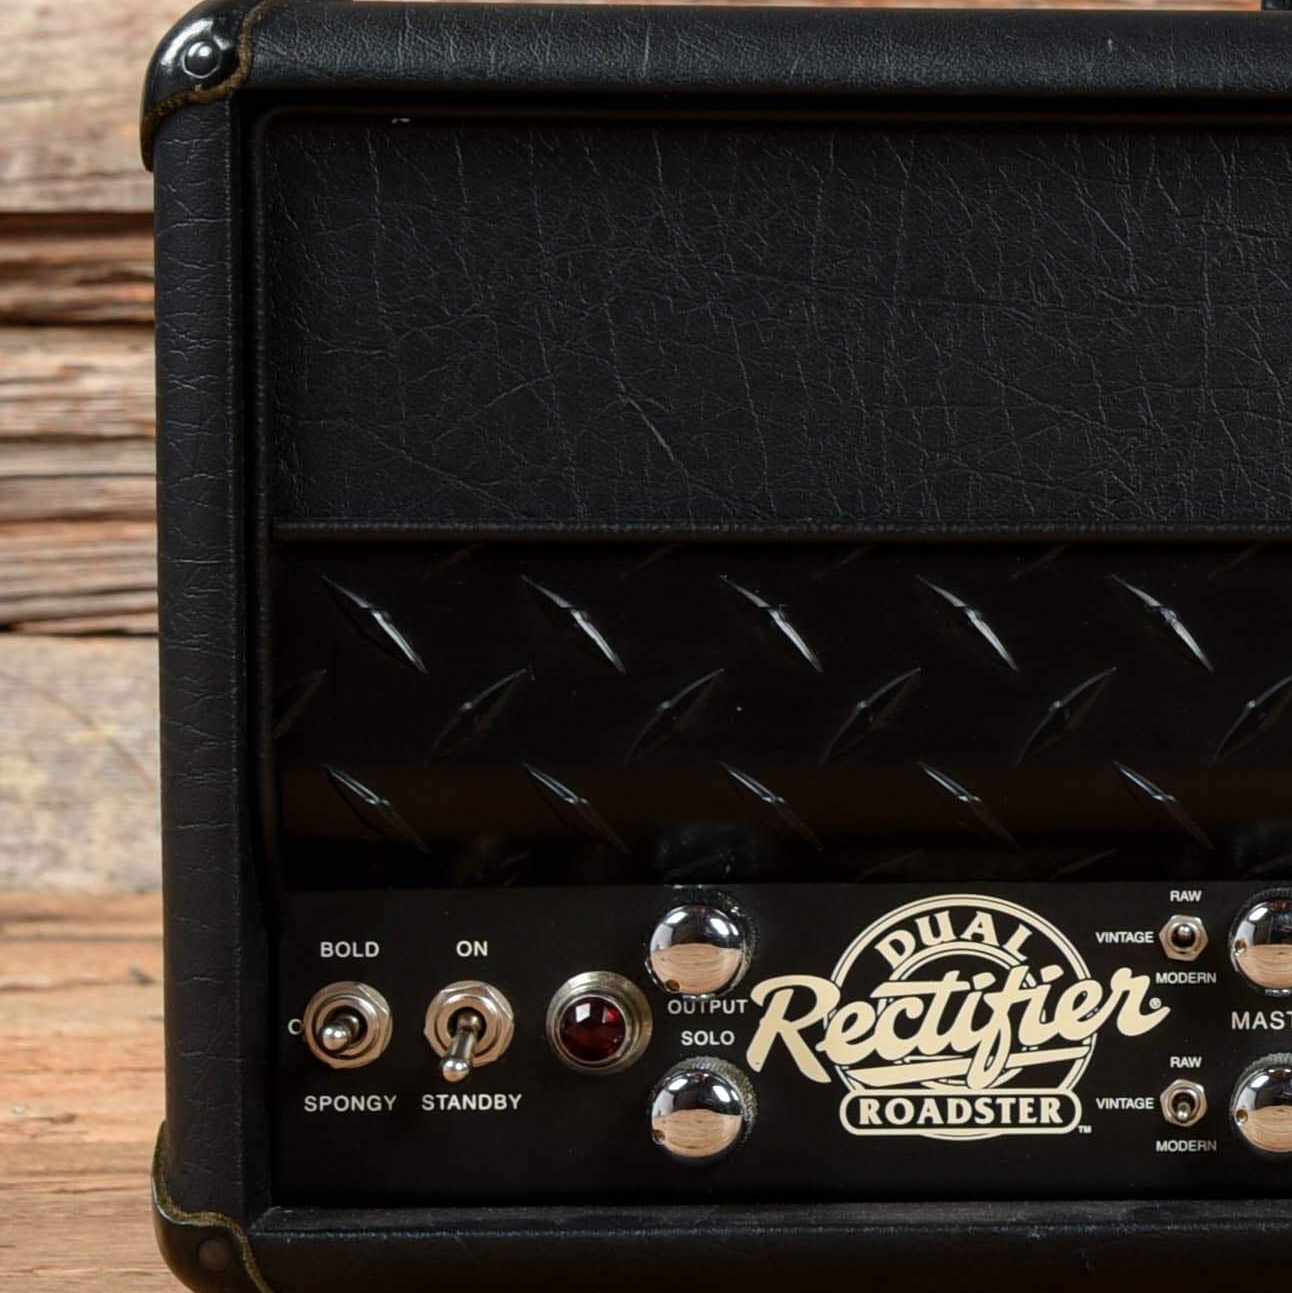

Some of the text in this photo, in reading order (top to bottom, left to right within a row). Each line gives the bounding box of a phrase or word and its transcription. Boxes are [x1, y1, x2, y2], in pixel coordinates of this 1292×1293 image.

[1169, 889, 1203, 902] RAW
[875, 910, 1034, 969] DUAL
[1095, 931, 1155, 944] VINTAGE
[320, 940, 380, 958] BOLD
[456, 939, 488, 958] ON
[1155, 972, 1217, 984] MODERN
[667, 999, 749, 1015] OUTPUT
[746, 965, 1171, 1090] Rectifier
[680, 1029, 736, 1047] SOLO
[1169, 1055, 1203, 1069] RAW
[304, 1094, 397, 1112] SPONGY
[421, 1093, 522, 1111] STANDBY
[859, 1095, 1064, 1126] ROADSTER
[1095, 1097, 1155, 1110] VINTAGE
[1155, 1139, 1218, 1153] MODERN
